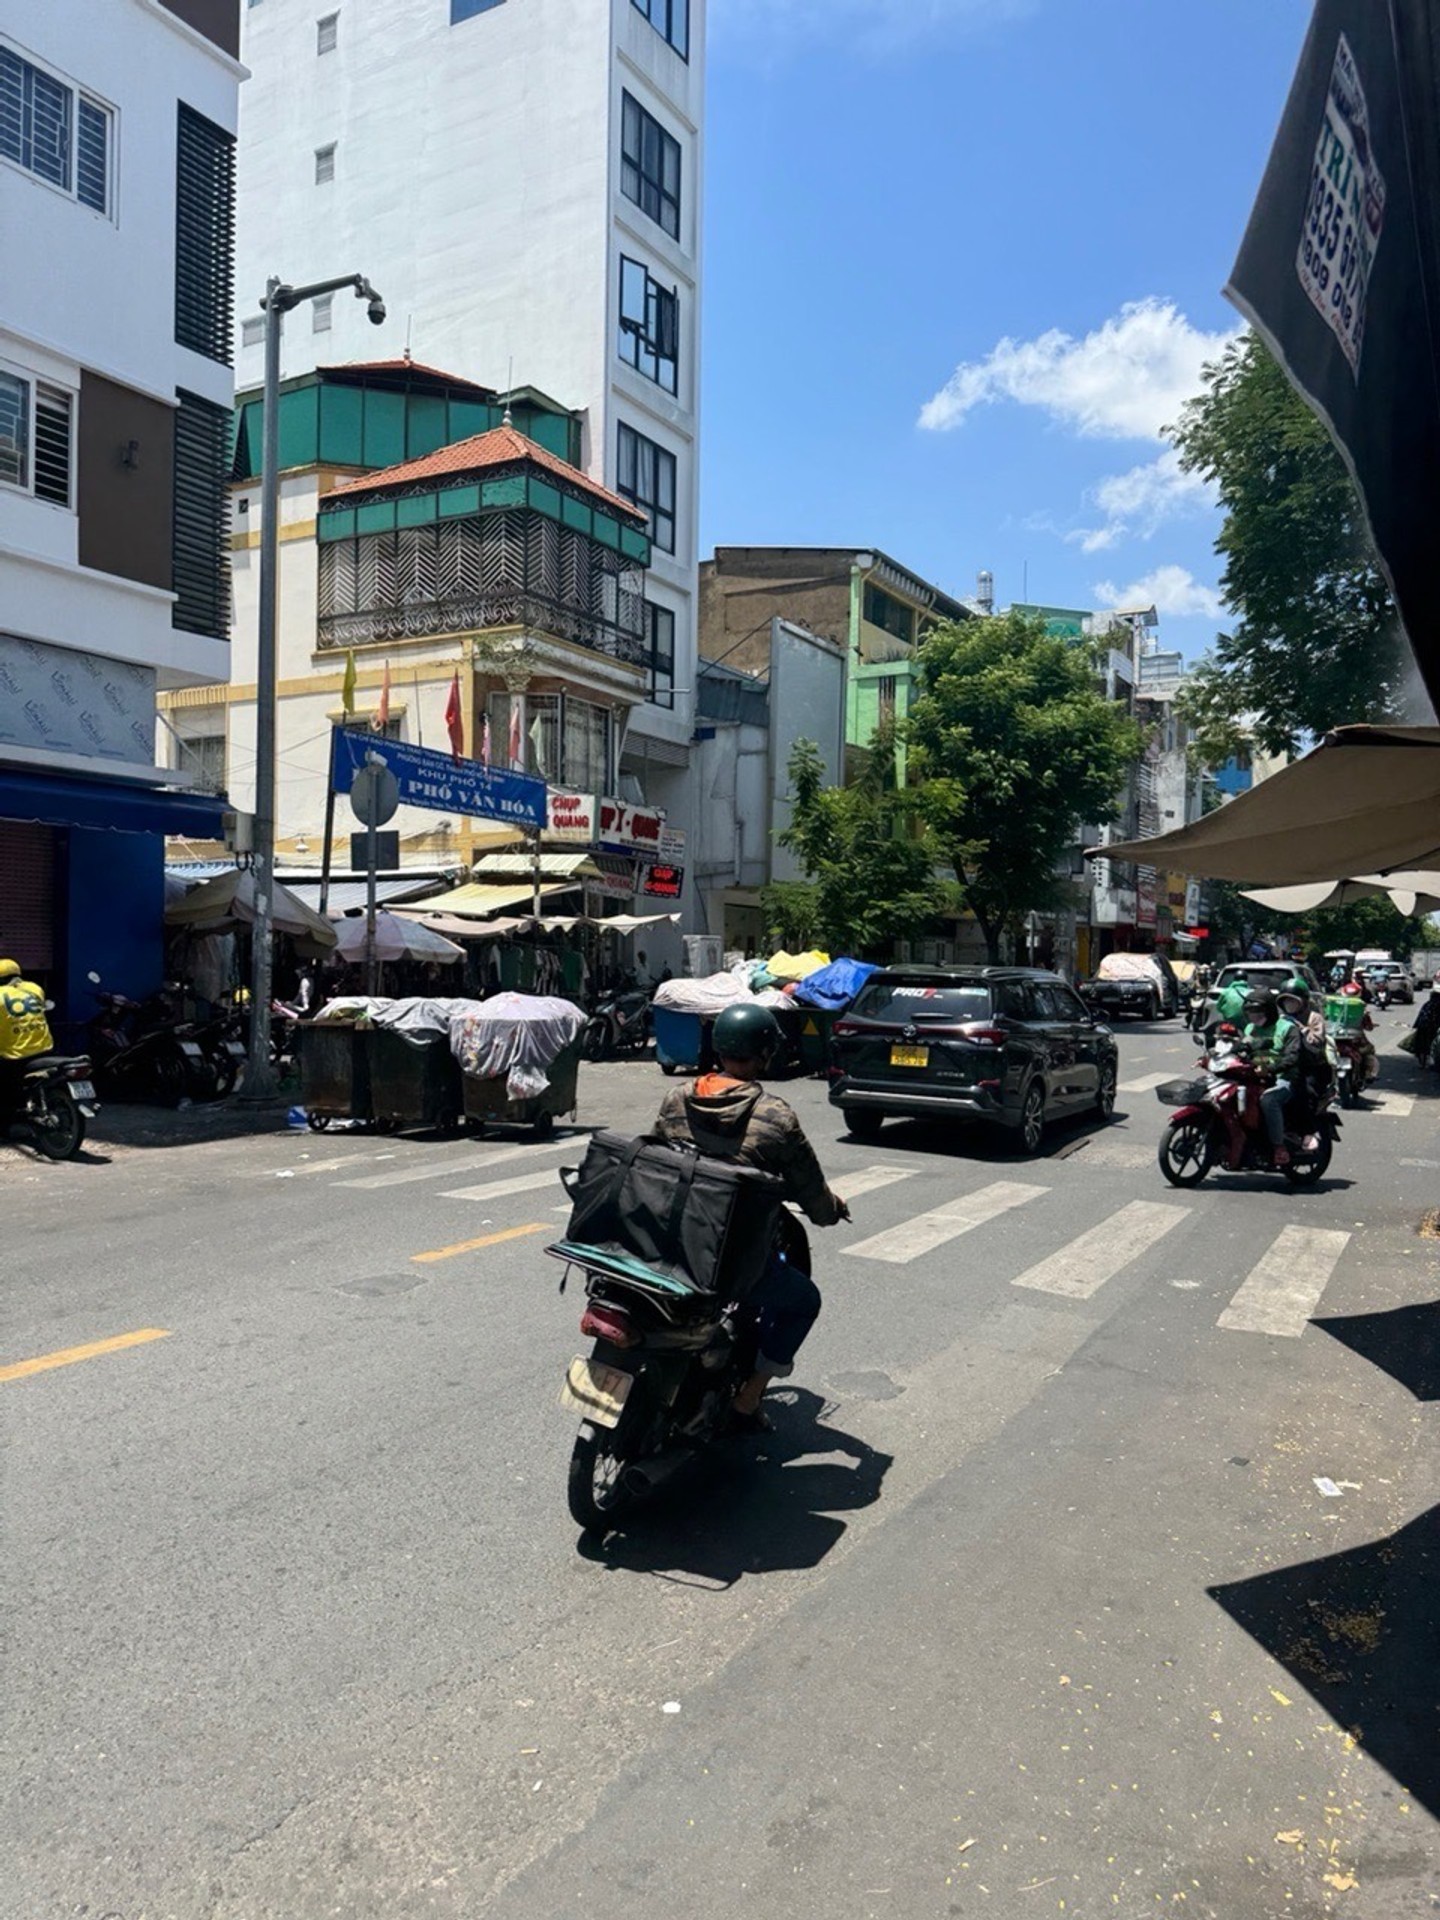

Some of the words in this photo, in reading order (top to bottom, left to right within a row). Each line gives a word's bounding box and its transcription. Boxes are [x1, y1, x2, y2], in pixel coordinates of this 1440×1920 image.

[417, 767, 447, 781] KHU
[480, 780, 492, 791] 14
[408, 779, 453, 800] PHỐ
[458, 787, 496, 809] VĂN
[500, 798, 536, 817] HÓA
[551, 795, 581, 813] CHỤP
[553, 814, 590, 829] QUANG
